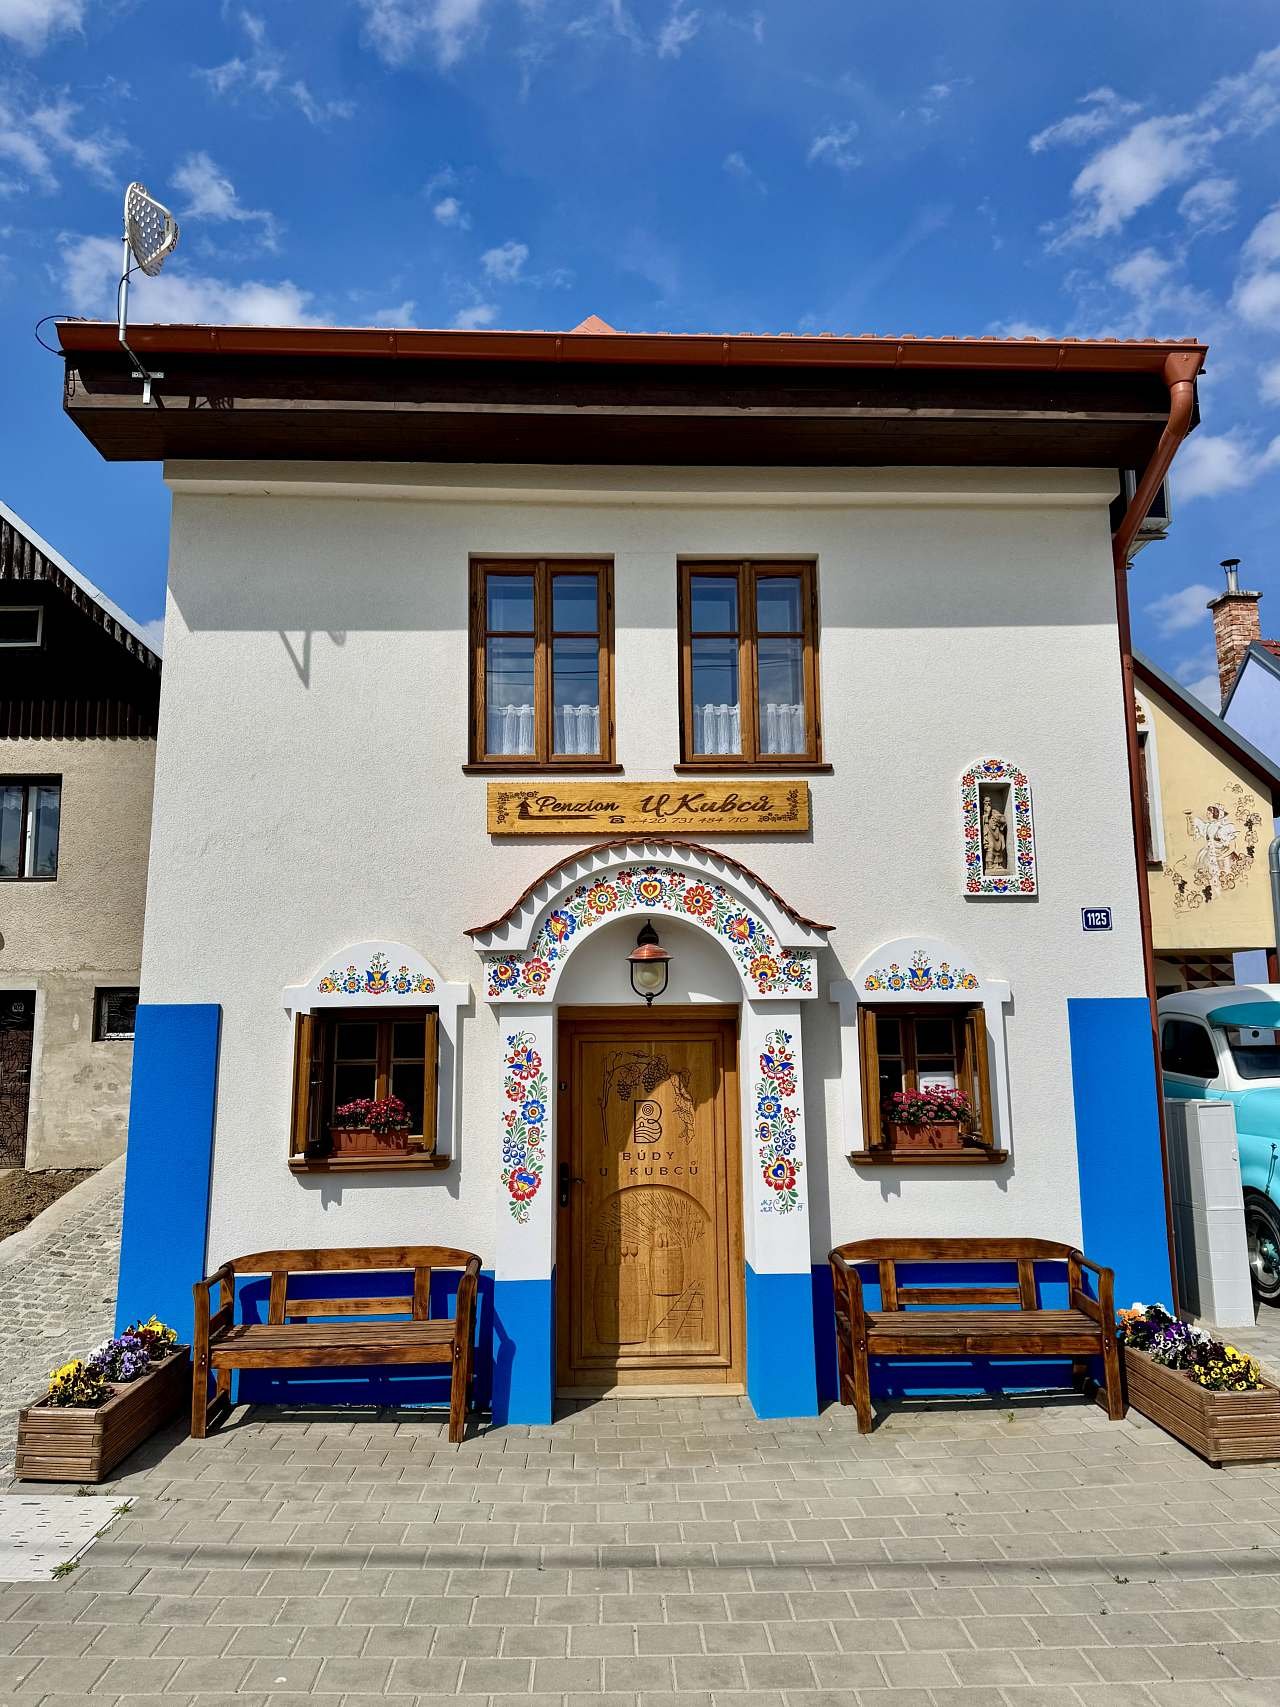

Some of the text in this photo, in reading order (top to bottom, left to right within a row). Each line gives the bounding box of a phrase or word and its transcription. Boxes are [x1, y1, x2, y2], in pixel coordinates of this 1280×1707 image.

[536, 793, 774, 817] Penzion U Kubců
[1087, 912, 1107, 926] 1125
[622, 1150, 674, 1161] BÚDY
[600, 1160, 699, 1177] U KUBCŮ
